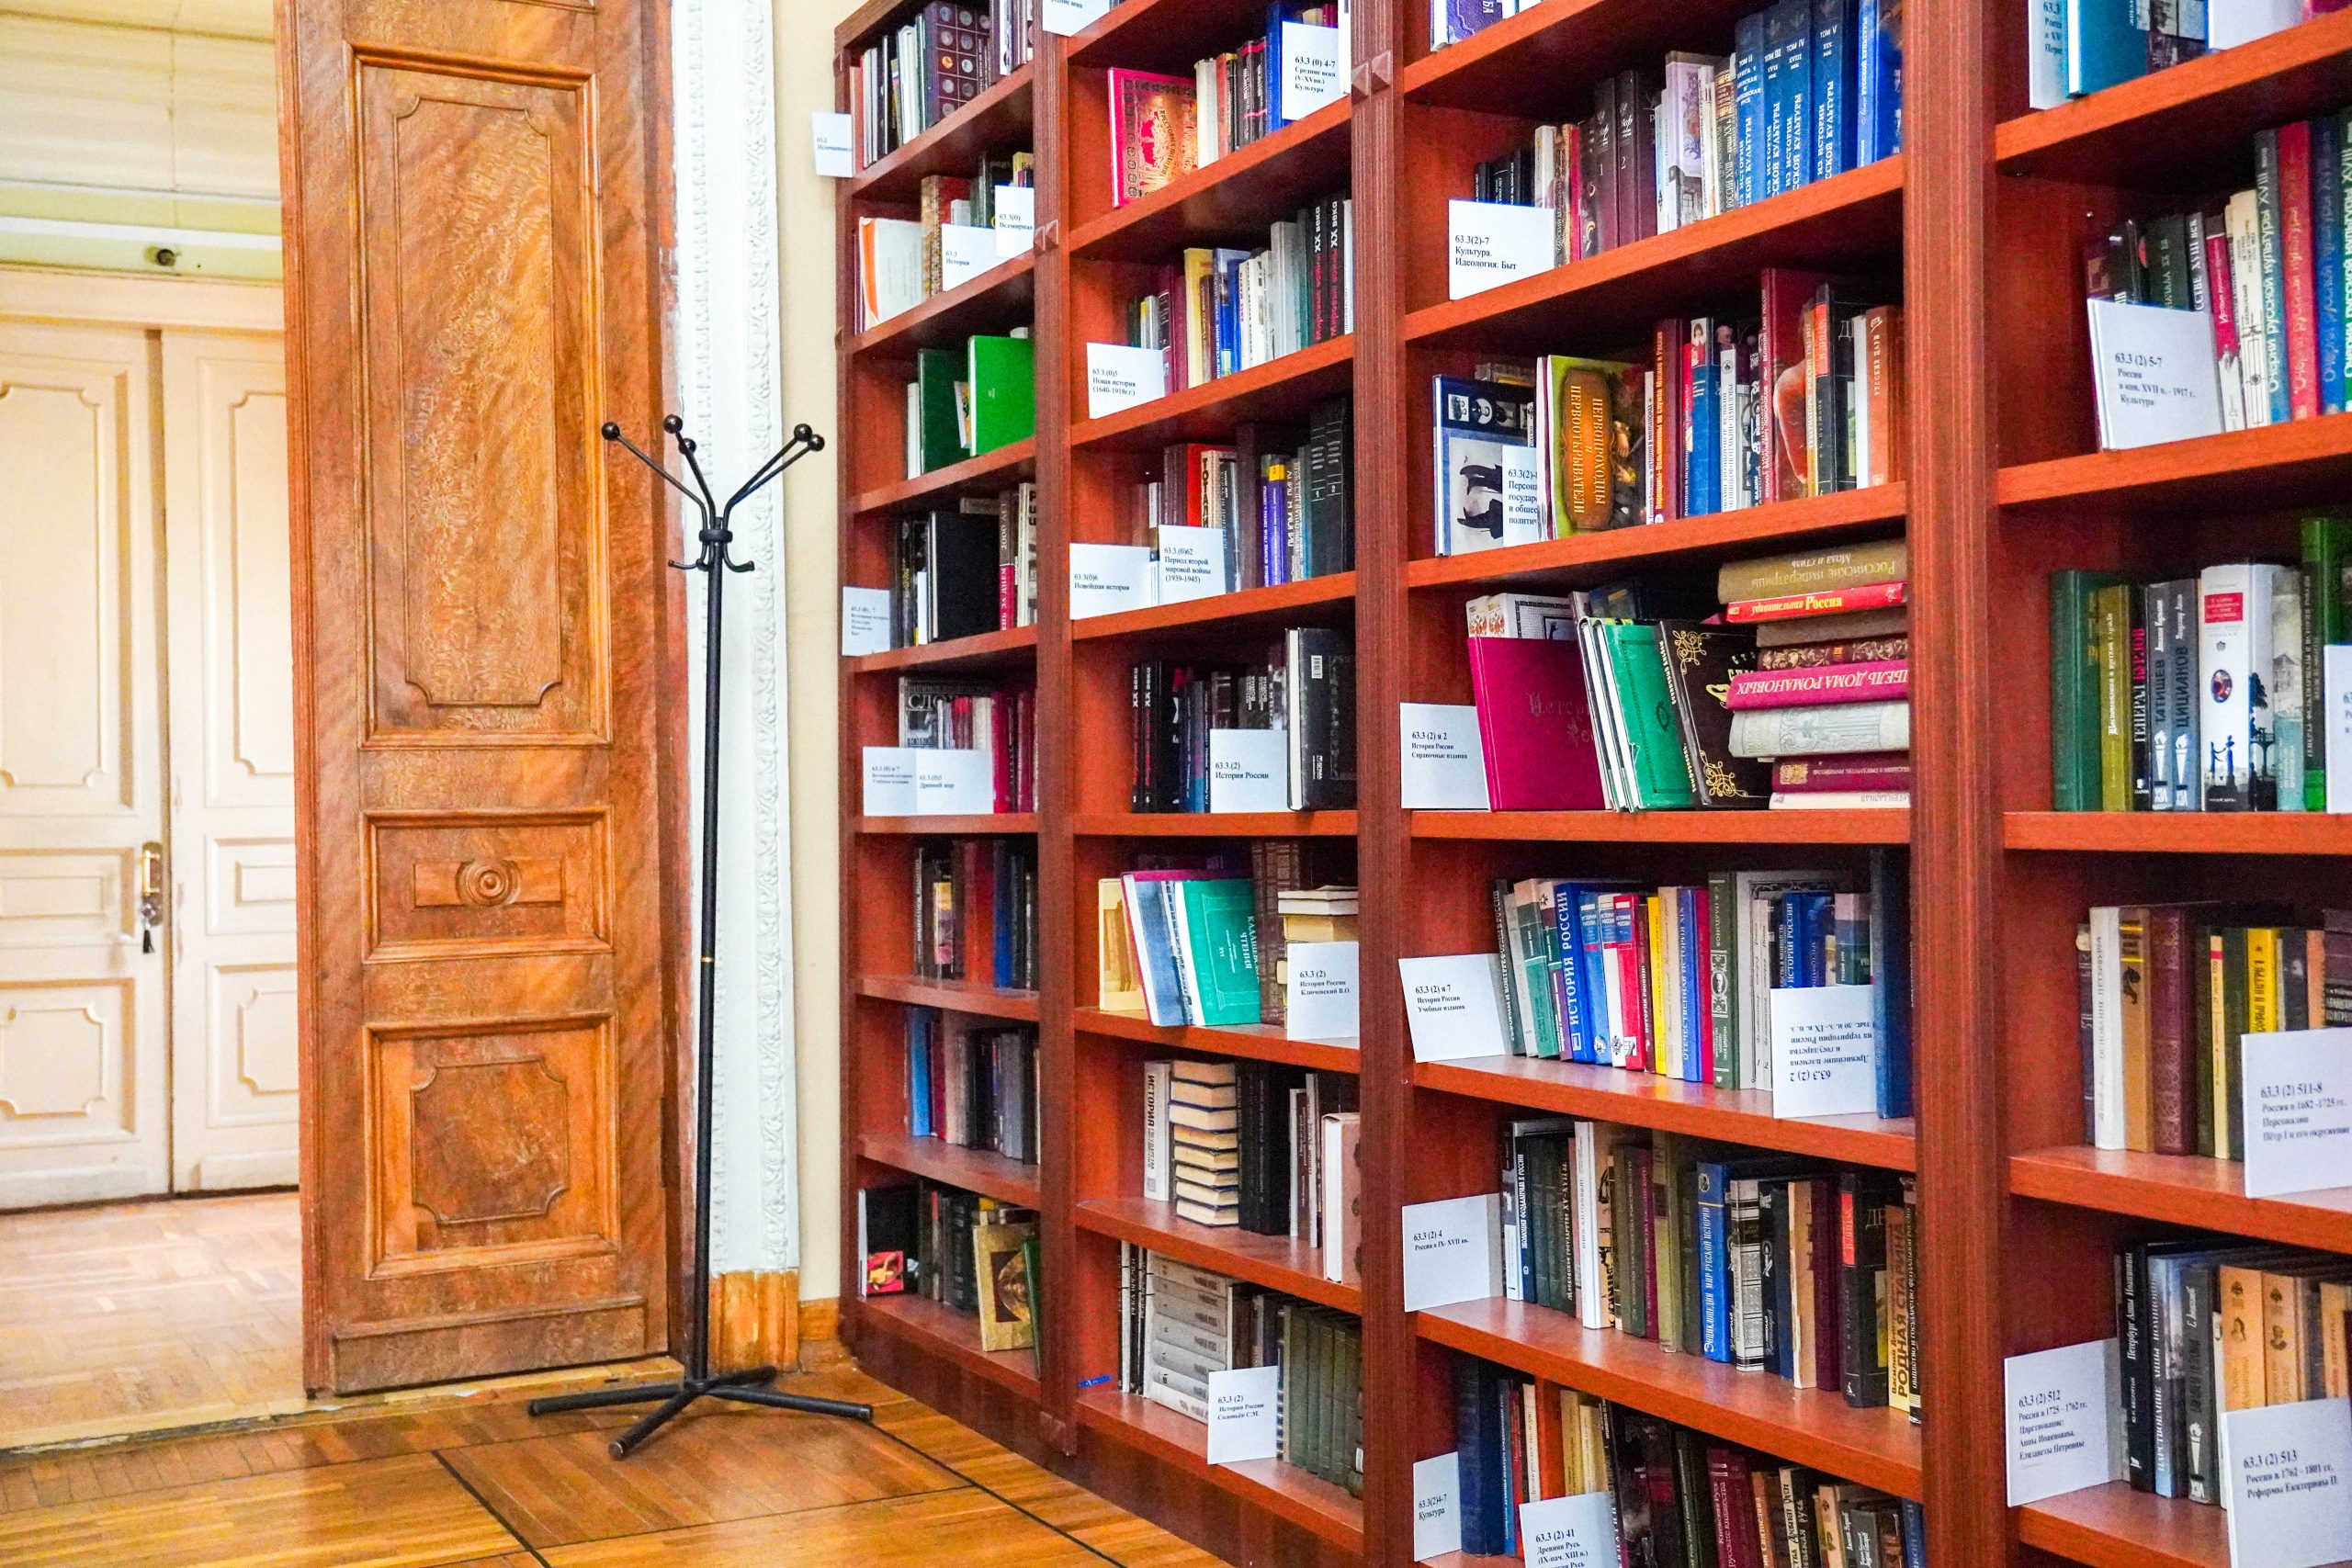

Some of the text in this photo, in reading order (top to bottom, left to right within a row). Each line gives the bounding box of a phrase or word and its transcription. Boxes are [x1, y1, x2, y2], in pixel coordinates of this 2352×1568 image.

[1295, 57, 1310, 65] 63.3
[1324, 60, 1336, 68] 4-7
[1295, 67, 1314, 75] Средние
[1295, 85, 1324, 94] Культура
[1793, 94, 1802, 151] КУЛЬТУРЫ
[2259, 173, 2268, 205] XVIII
[1455, 235, 1489, 245] 63.3(2)-7
[2264, 210, 2274, 273] культуры
[1455, 247, 1492, 257] Культура.
[1455, 257, 1516, 269] Идеология. Быт
[2267, 277, 2278, 333] русской
[2115, 353, 2162, 367] 63.3 (2) 5-7
[2269, 339, 2278, 392] Очерки
[1112, 379, 1136, 388] история
[2142, 385, 2188, 396] XVII 1917
[2120, 395, 2154, 406] Культура
[1570, 386, 1584, 513] ПЕРВООТКРЫВАТЕЛИ
[1592, 399, 1605, 505] ПЕРВОПРОХОДЦЫ
[1165, 557, 1187, 565] Период
[1165, 566, 1190, 576] мировой
[1074, 581, 1104, 590] Новейшая
[1805, 596, 1842, 610] Россия
[1736, 677, 1823, 694] РОМАНОВЫХ
[1826, 674, 1861, 691] ДОМА
[2175, 647, 2188, 728] ЦИЦИАНОВ
[2154, 659, 2165, 723] ТАТИЩЕВ
[2133, 685, 2145, 743] ГЕНЕРАЛ
[1427, 732, 1436, 740] (2)
[1557, 891, 1579, 1025] ИСТОРИЯ РОССИИ
[1299, 970, 1326, 978] 63.3 (2)
[1431, 986, 1440, 994] (2)
[1821, 1033, 1859, 1043] территории
[1824, 1055, 1869, 1066] Древнейшие
[1790, 1070, 1831, 1082] 63.3 (2) 2
[2261, 1082, 2323, 1098] 63.3 (2) 511-8
[1413, 1232, 1427, 1241] 63.3
[1428, 1231, 1437, 1239] (2)
[1894, 1221, 1908, 1398] РОДНАЯ СТАРИНА
[2127, 1322, 2137, 1360] Петербург
[1218, 1394, 1233, 1404] 63.3
[2019, 1390, 2061, 1407] 63.3 (2) 512
[2019, 1412, 2039, 1421] Россия
[2020, 1438, 2037, 1447] Анны
[2054, 1441, 2084, 1452] Петровны
[2244, 1450, 2297, 1468] 63.3 (2) 513
[2247, 1487, 2283, 1499] Реформы
[2286, 1480, 2328, 1492] Екатерины
[1419, 1507, 1444, 1521] Культура
[1535, 1529, 1575, 1542] 63.3 (2) 41
[1566, 1541, 1580, 1551] Русь
